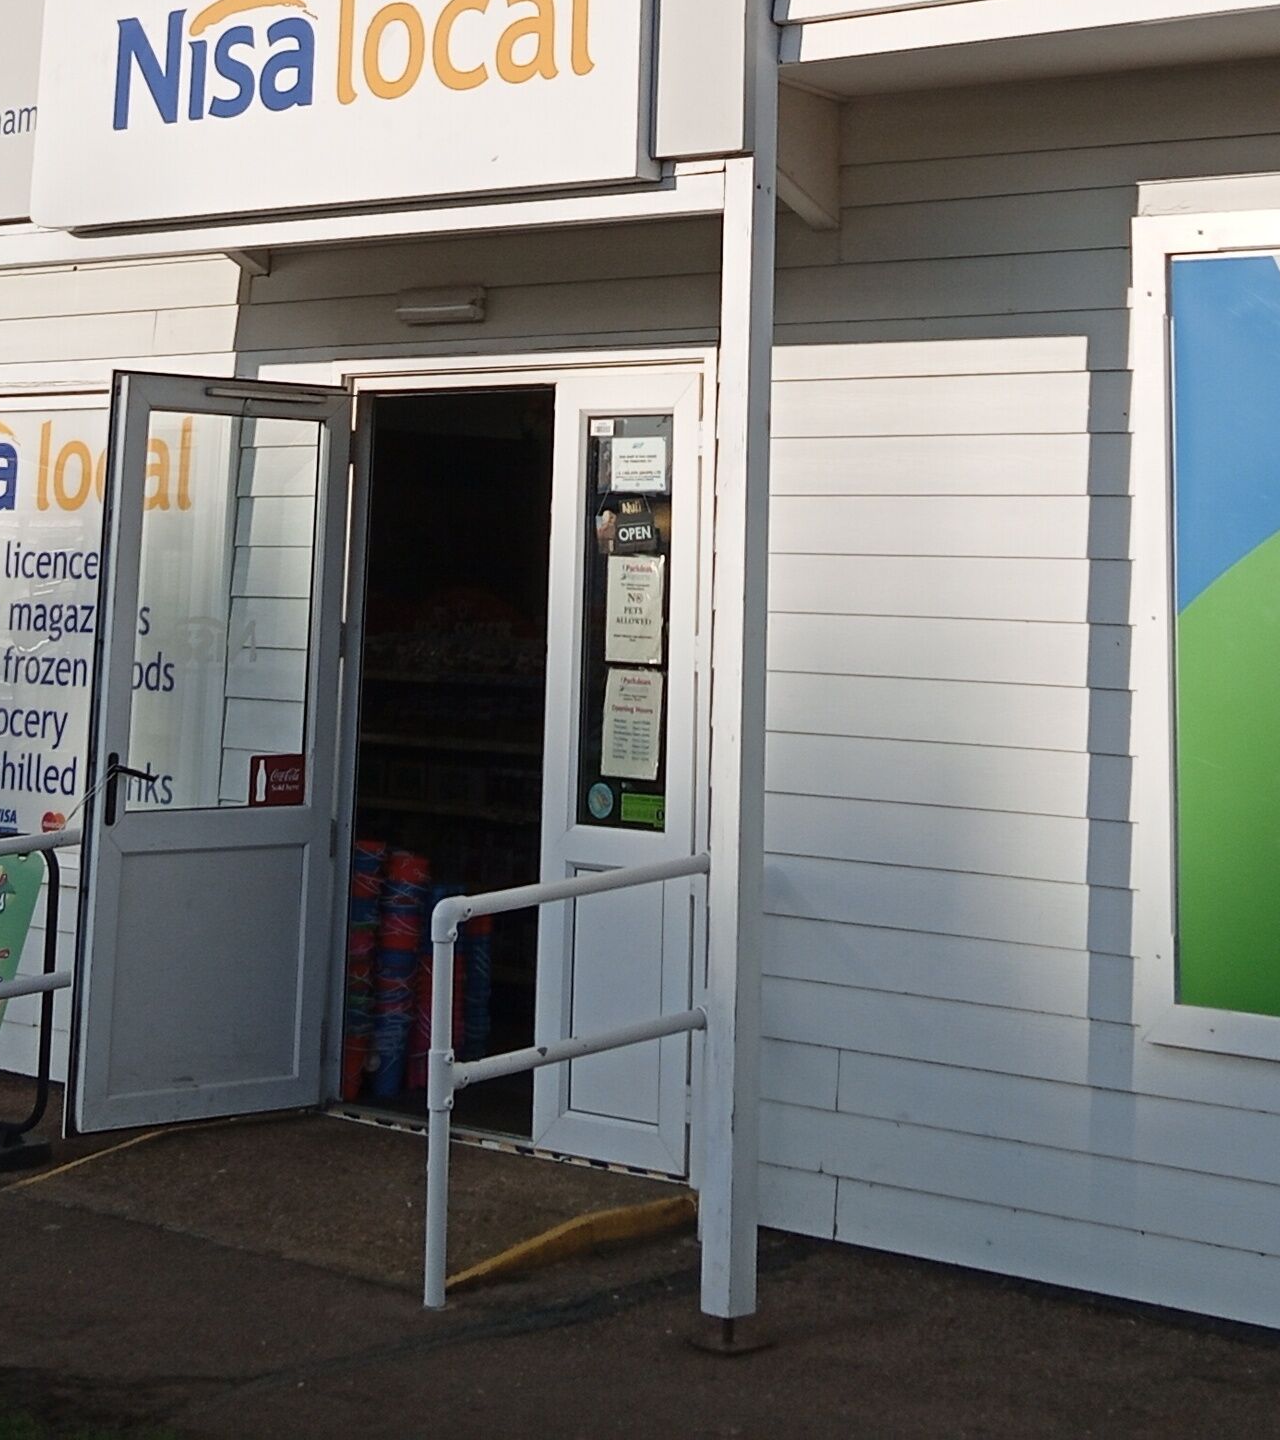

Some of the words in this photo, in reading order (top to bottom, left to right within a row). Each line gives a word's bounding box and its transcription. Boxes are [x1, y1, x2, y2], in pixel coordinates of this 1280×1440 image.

[618, 525, 652, 541] OPEN
[5, 541, 99, 580] licence
[3, 645, 87, 687] frozen
